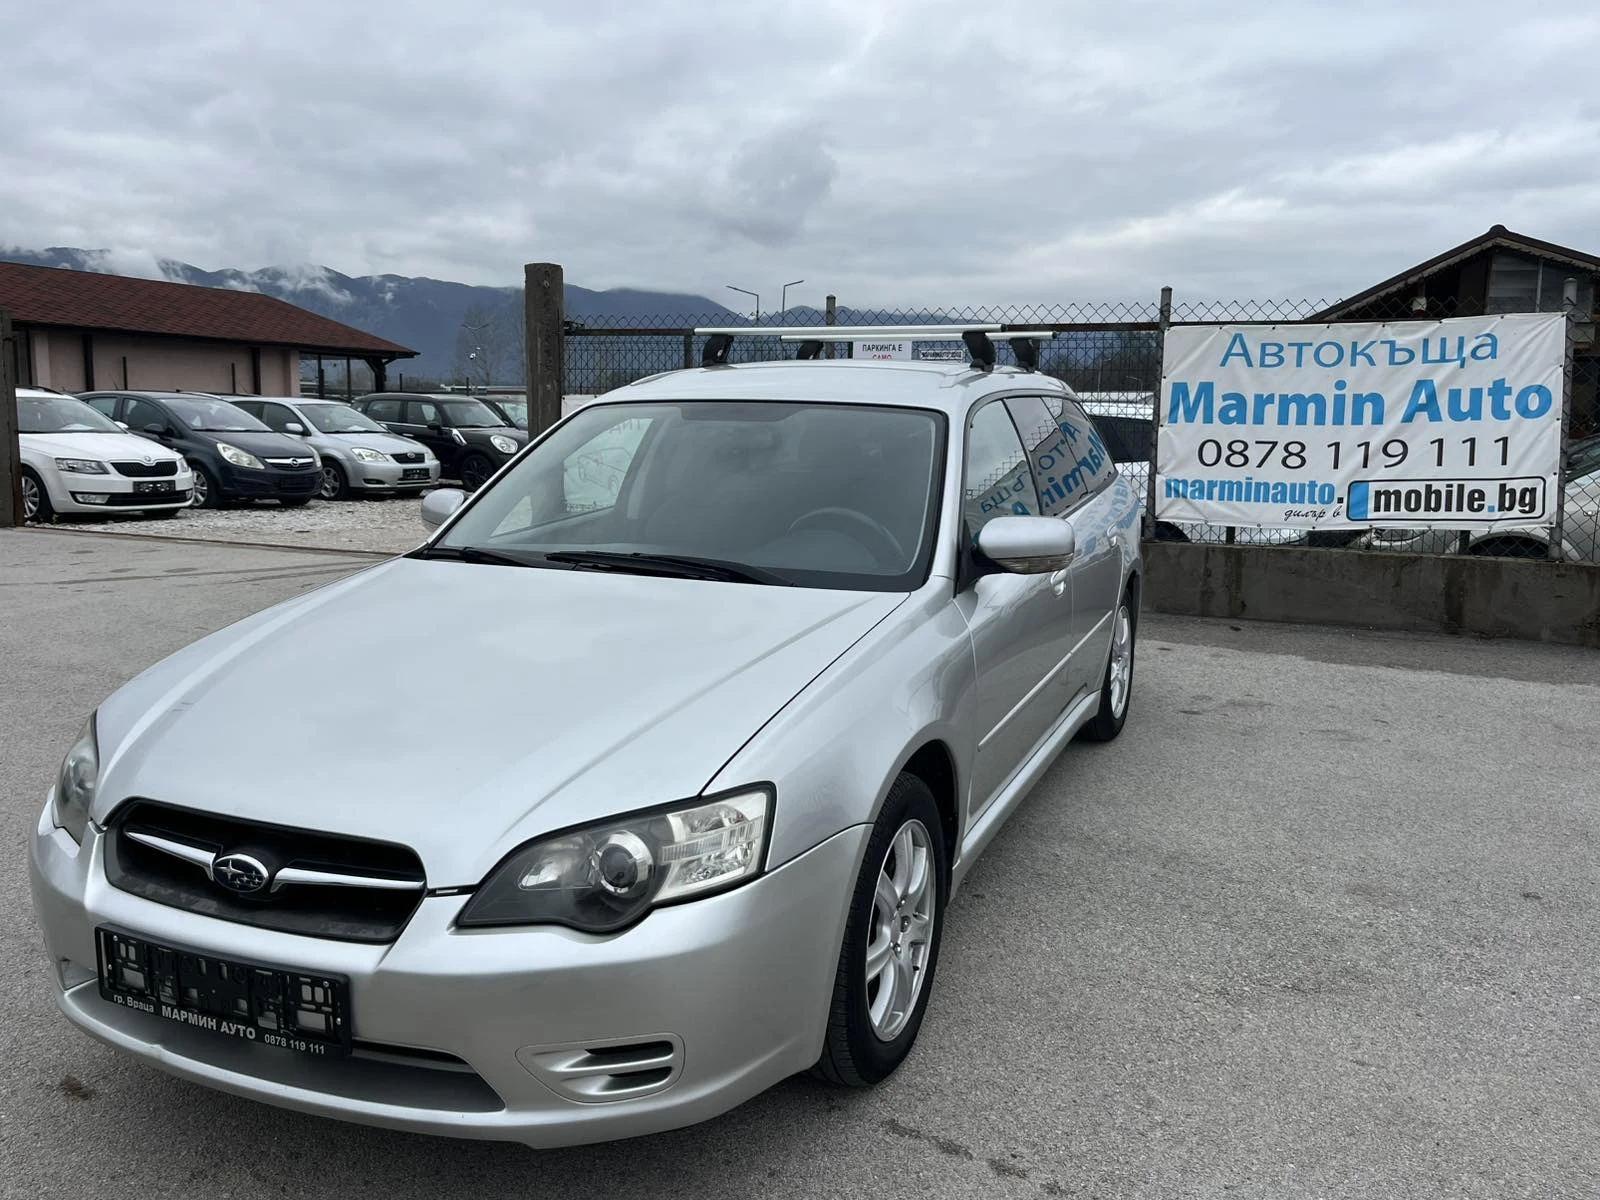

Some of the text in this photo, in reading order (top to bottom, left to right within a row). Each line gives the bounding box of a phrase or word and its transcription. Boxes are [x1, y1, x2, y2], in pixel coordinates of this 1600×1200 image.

[862, 344, 896, 352] ПАРКИНГА
[1220, 332, 1498, 369] Автокъща
[1167, 377, 1552, 427] Marmin Auto
[1199, 437, 1510, 470] 0878 119 111
[1373, 483, 1538, 514] mobile.bg
[113, 994, 325, 1055] гр. Враца МАРМИН АУТО 0878 119 111
